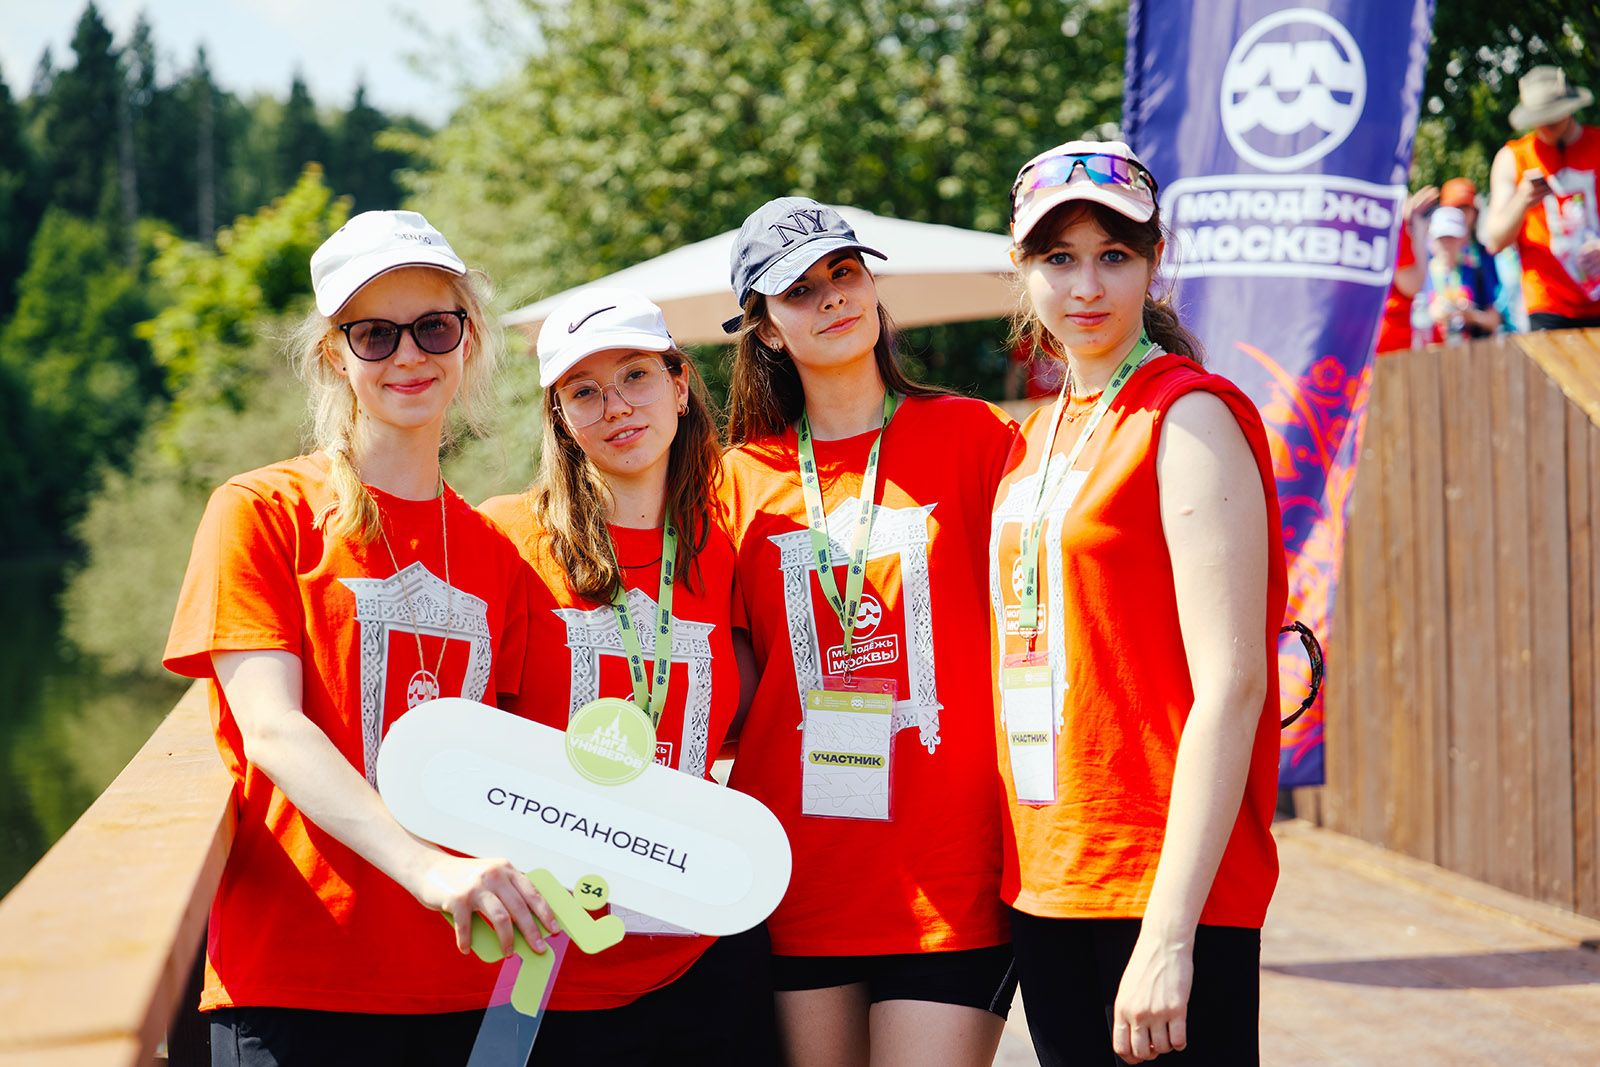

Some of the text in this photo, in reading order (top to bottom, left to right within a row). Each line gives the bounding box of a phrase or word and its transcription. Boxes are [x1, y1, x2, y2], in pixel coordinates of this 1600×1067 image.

[1177, 187, 1393, 229] МОЛОДЁЖЬ
[768, 209, 828, 248] NY
[1176, 225, 1389, 271] МОСКВЫ
[832, 650, 894, 670] МОСКВЫ
[570, 735, 643, 769] УНИВЕРОВ
[590, 729, 628, 753] ЛИГА
[1011, 733, 1047, 743] УЧАСТНИК
[812, 753, 881, 766] УЧАСТНИК
[486, 787, 688, 873] СТРОГАНОВЕЦ
[580, 882, 604, 898] 34
